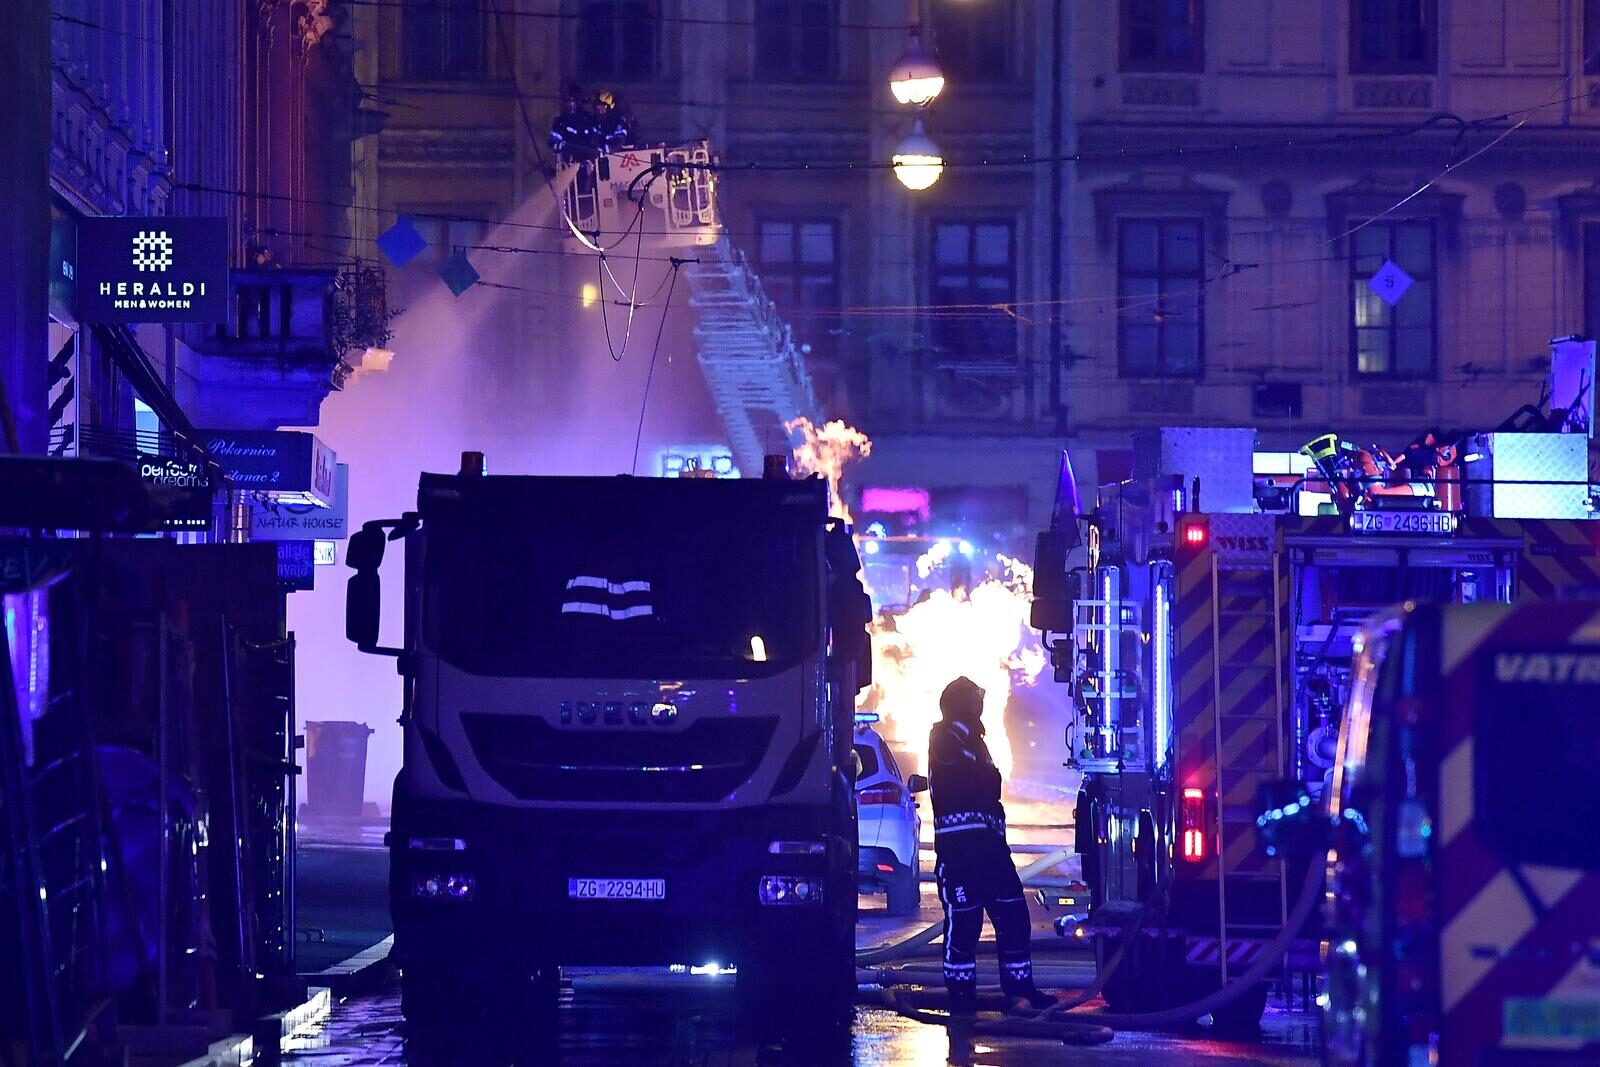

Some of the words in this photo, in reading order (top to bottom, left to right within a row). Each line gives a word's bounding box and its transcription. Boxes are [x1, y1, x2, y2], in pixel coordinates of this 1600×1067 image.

[100, 282, 205, 296] HERALDI
[114, 299, 191, 309] MEN&WOMEN
[207, 439, 278, 457] Pekarnica
[302, 517, 344, 529] HOUSE
[1365, 514, 1383, 530] ZG
[560, 701, 679, 725] IVECO
[579, 881, 597, 897] ZG
